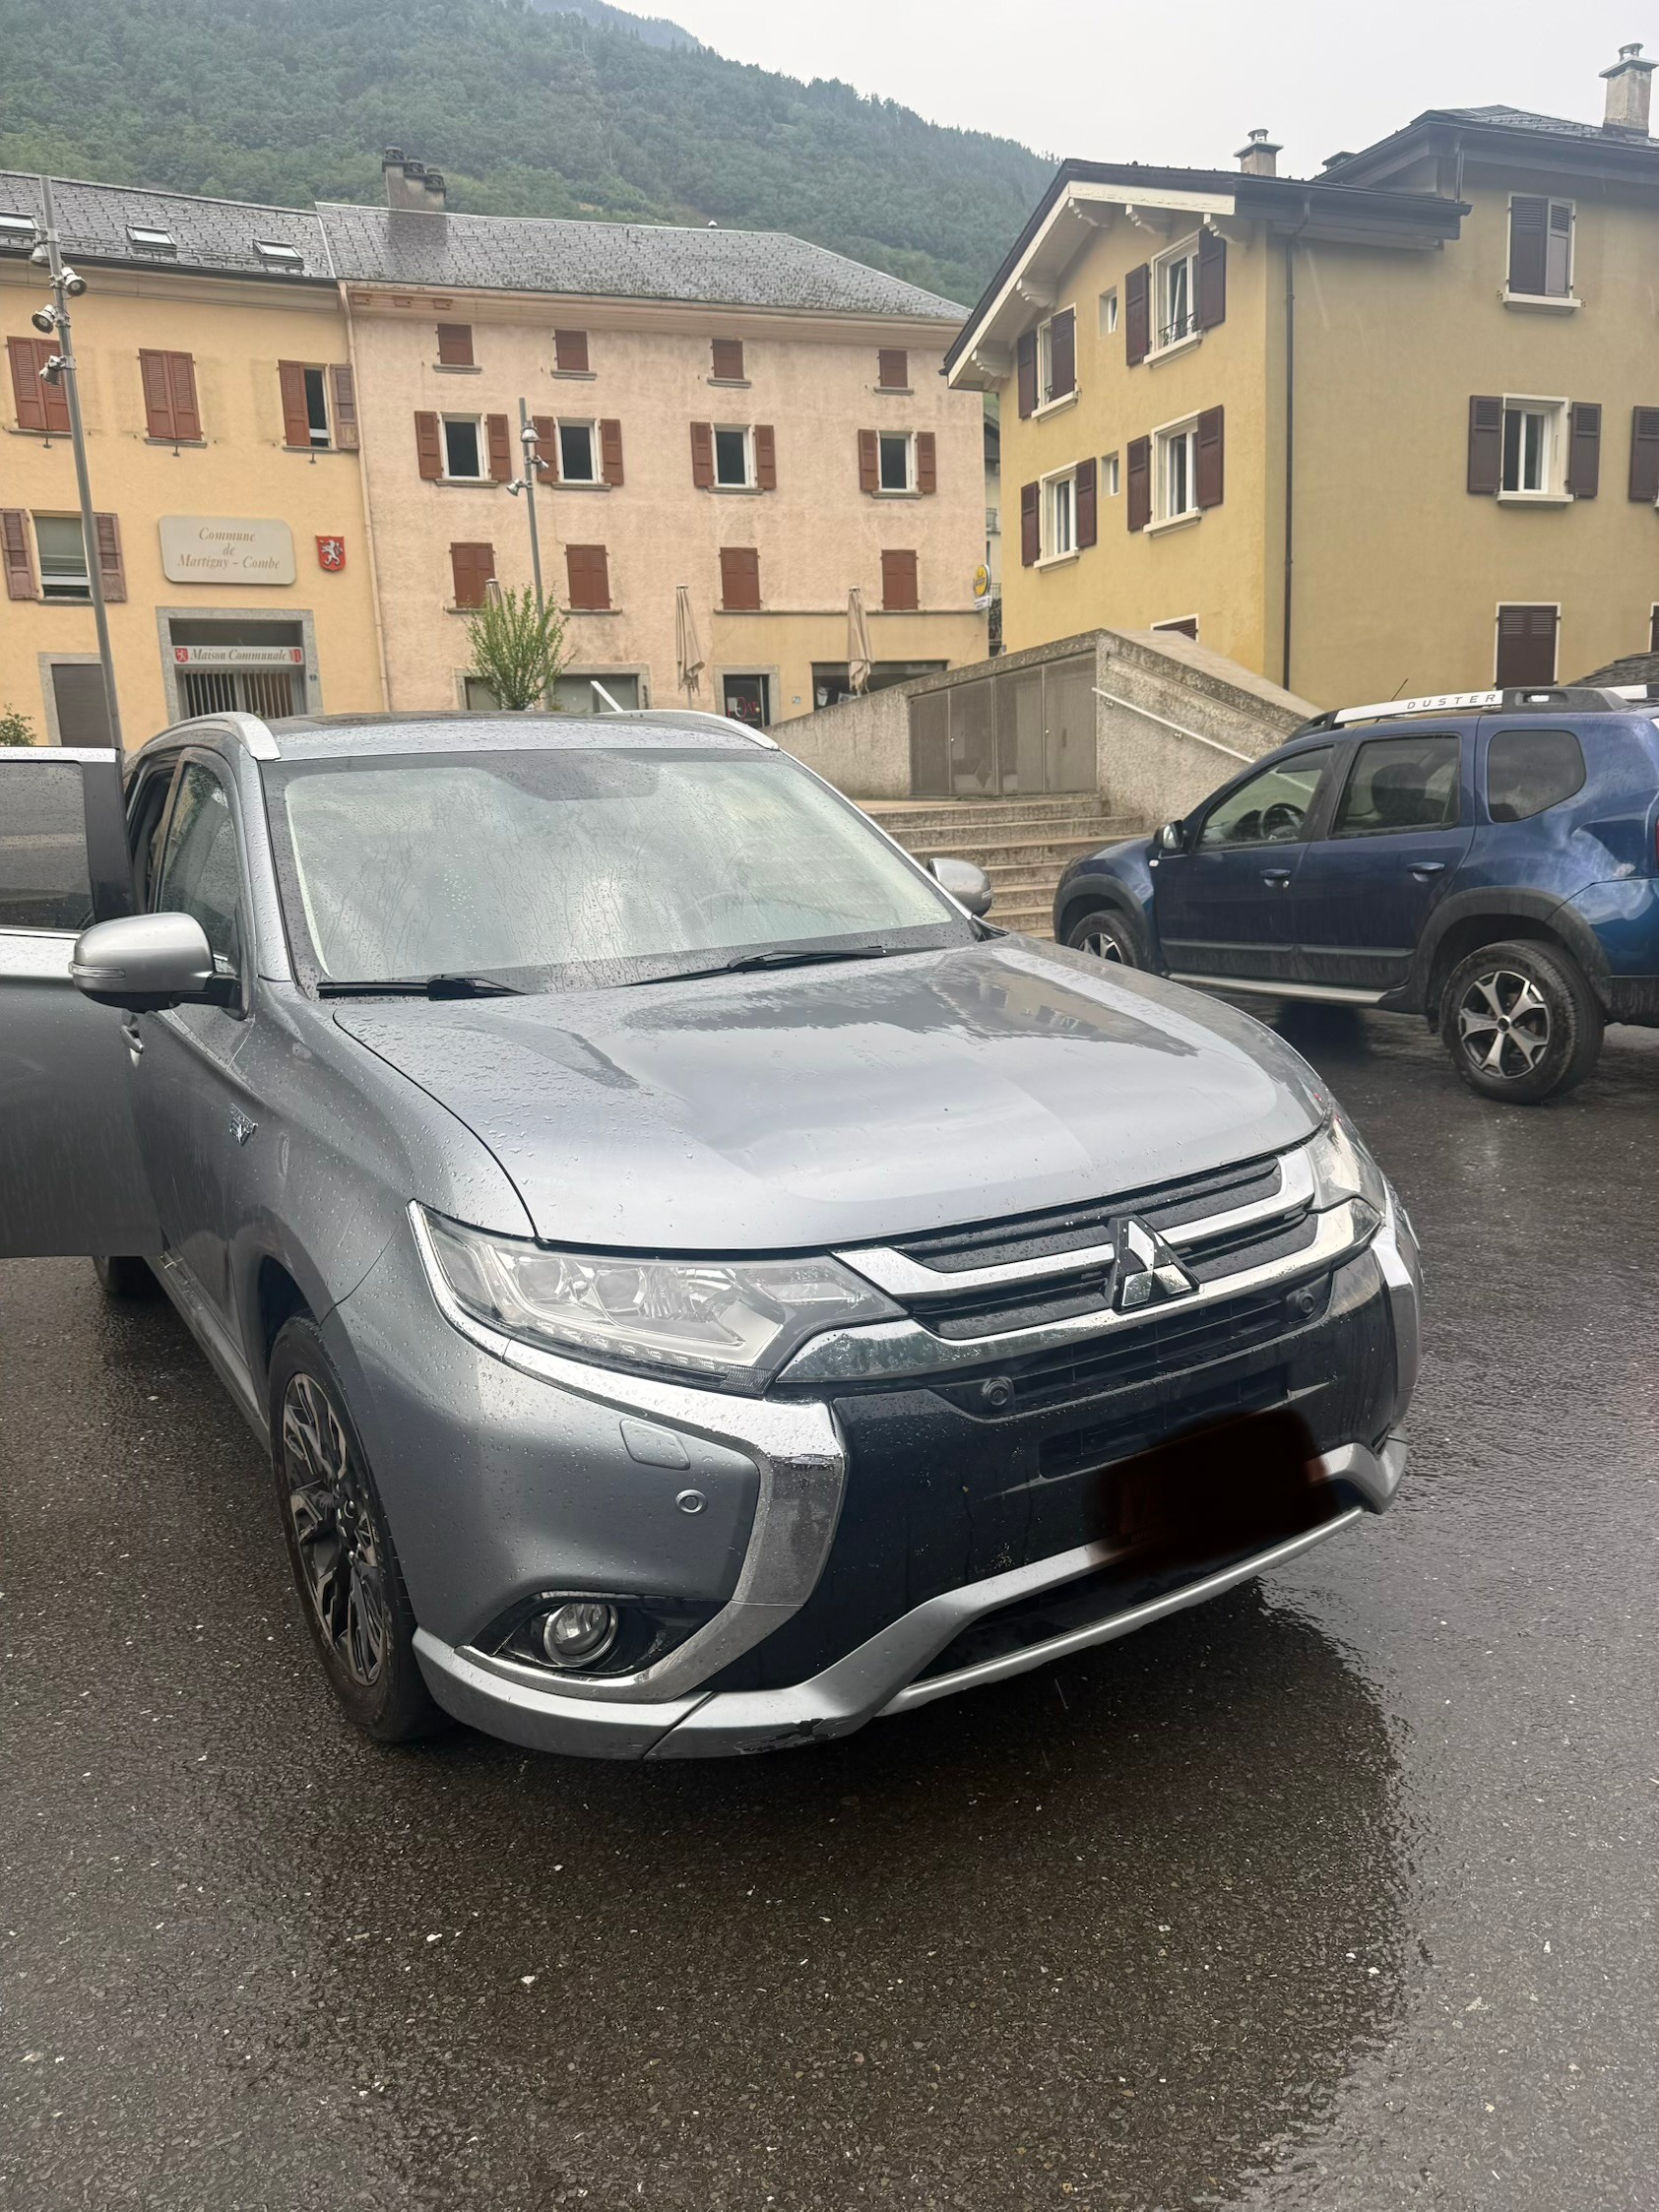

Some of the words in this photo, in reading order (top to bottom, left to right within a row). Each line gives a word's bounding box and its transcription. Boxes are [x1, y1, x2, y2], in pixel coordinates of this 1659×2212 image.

[199, 527, 256, 542] Commune
[223, 542, 236, 556] de
[177, 554, 228, 570] Martigny
[242, 556, 281, 569] Combe
[190, 649, 226, 661] Maison
[228, 649, 287, 662] Communale
[1407, 693, 1497, 710] DUSTER
